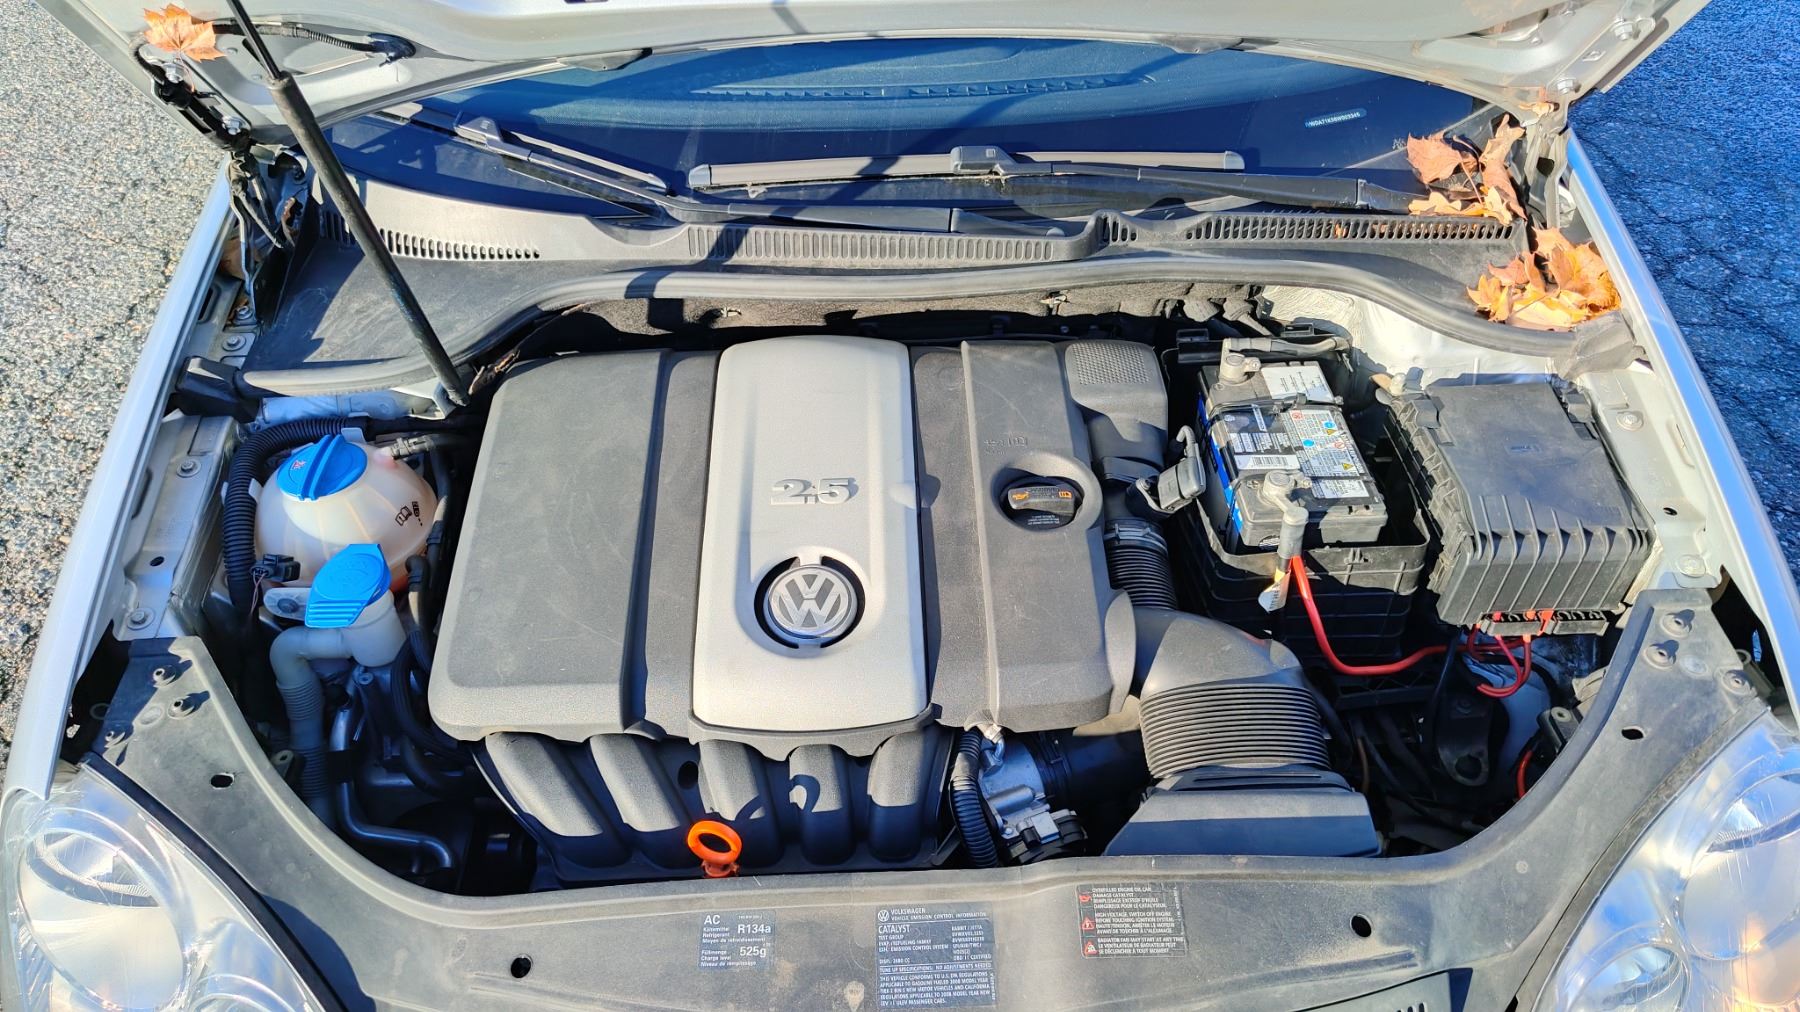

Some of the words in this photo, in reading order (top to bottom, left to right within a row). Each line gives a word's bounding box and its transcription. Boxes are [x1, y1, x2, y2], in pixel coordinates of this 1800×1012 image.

[770, 477, 852, 506] 2.5
[704, 915, 720, 924] AC
[738, 924, 771, 933] R134a
[878, 925, 910, 934] CATALYST
[740, 946, 766, 957] 525g
